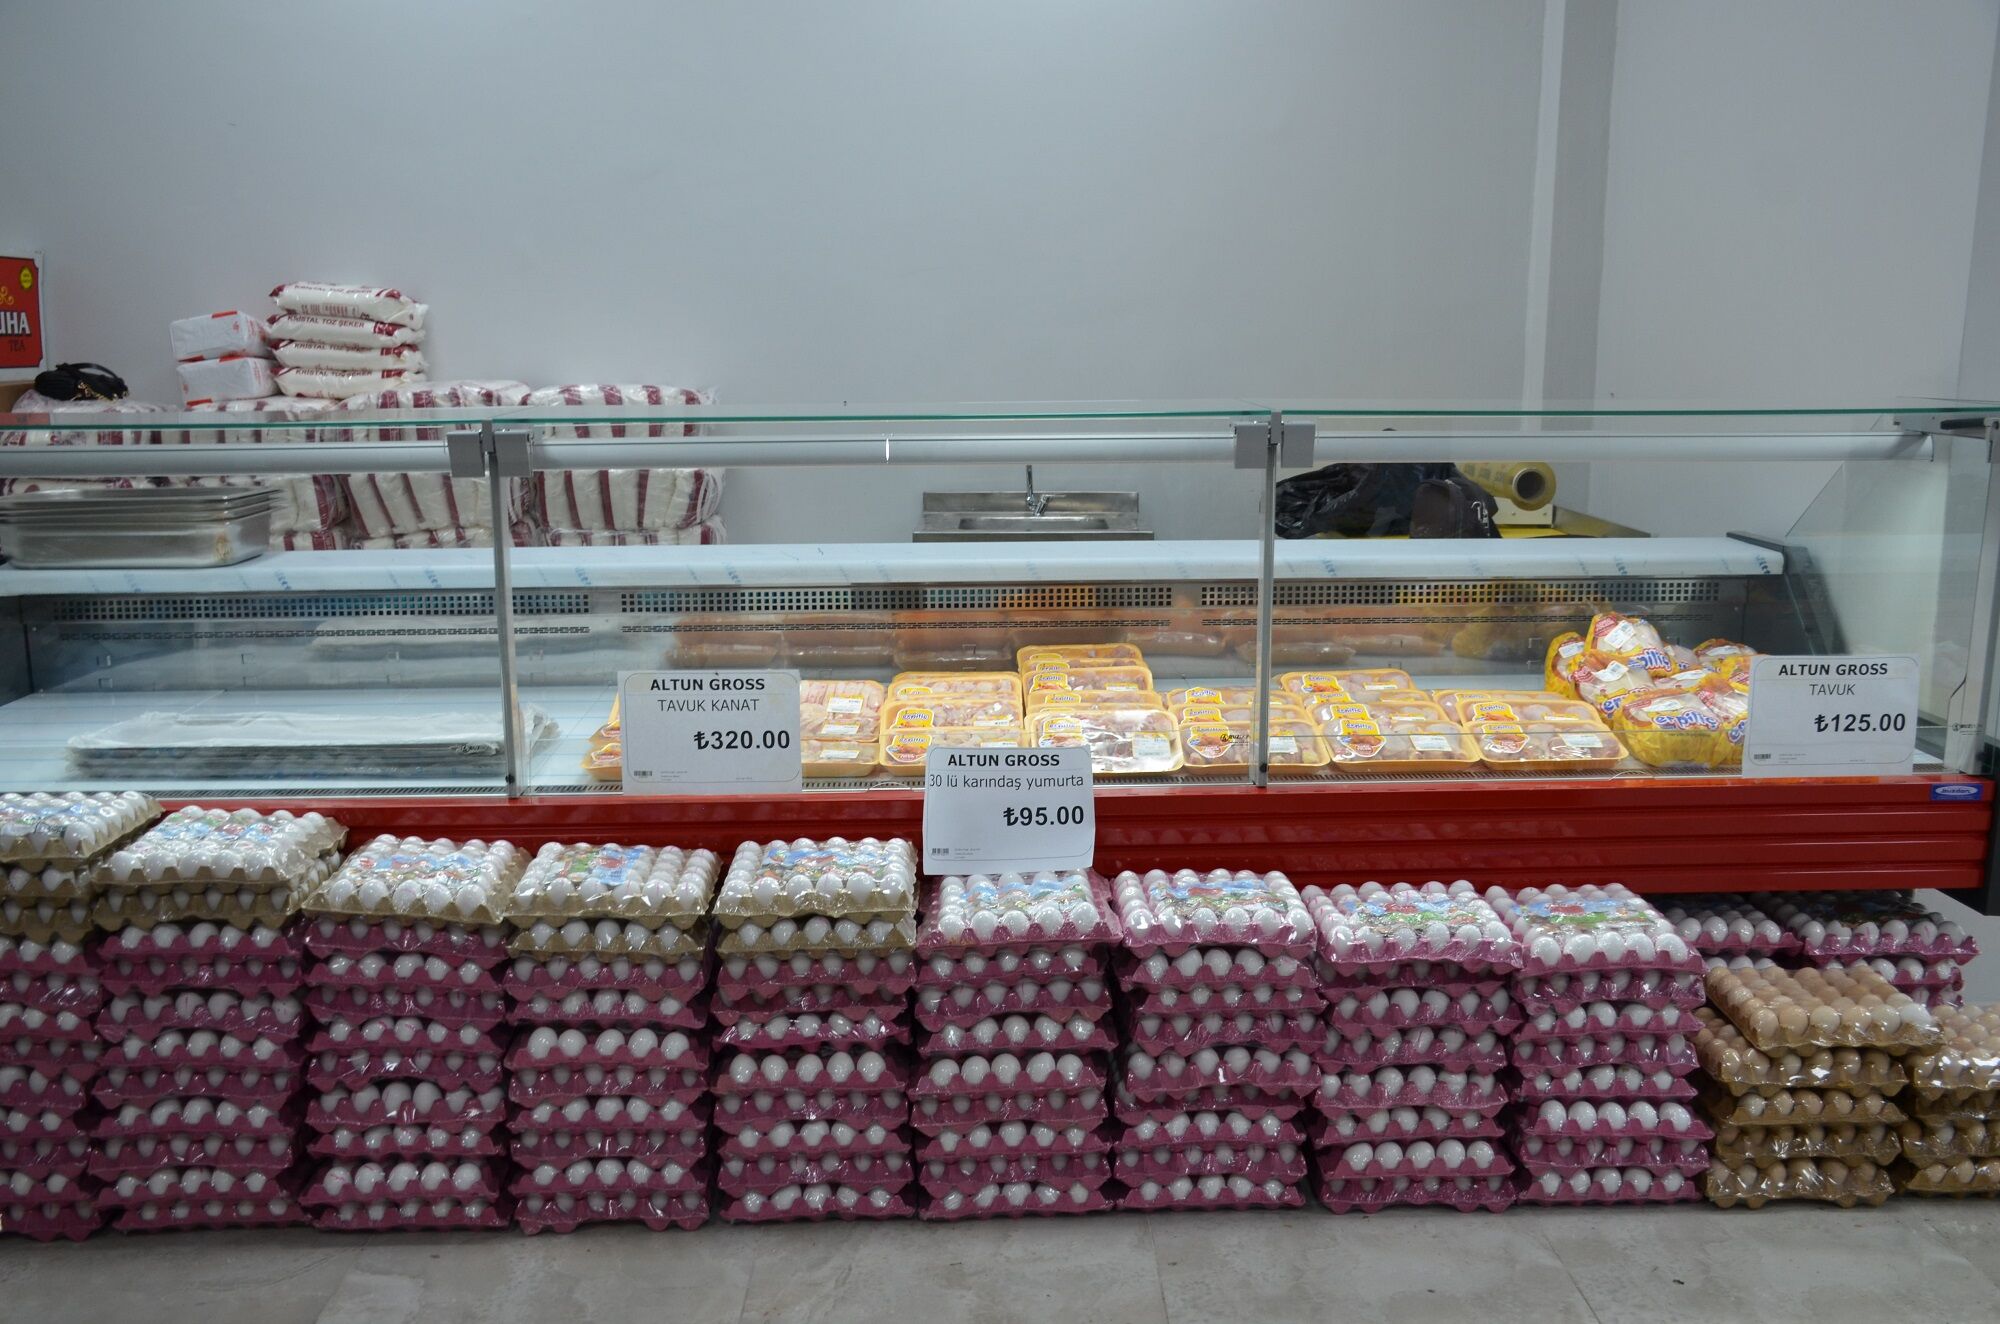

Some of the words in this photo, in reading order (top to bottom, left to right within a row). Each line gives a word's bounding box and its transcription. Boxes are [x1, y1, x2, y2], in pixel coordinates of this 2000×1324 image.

[322, 318, 337, 326] TOZ
[1778, 663, 1830, 676] ALTUN
[1835, 662, 1889, 676] GROSS
[650, 678, 704, 691] ALTUN
[709, 677, 766, 691] GROSS
[1809, 683, 1856, 696] TAVUK
[657, 698, 706, 712] TAVUK
[711, 698, 760, 712] KANAT
[1813, 712, 1907, 733] ₺125.00
[693, 729, 791, 750] ₺320.00
[948, 754, 999, 767] ALTUN
[1004, 754, 1061, 767] GROSS
[929, 774, 943, 788] 30
[946, 774, 958, 788] lü
[963, 774, 1022, 791] karındaş
[1027, 774, 1084, 790] yumurta
[1002, 805, 1085, 827] ₺95.00
